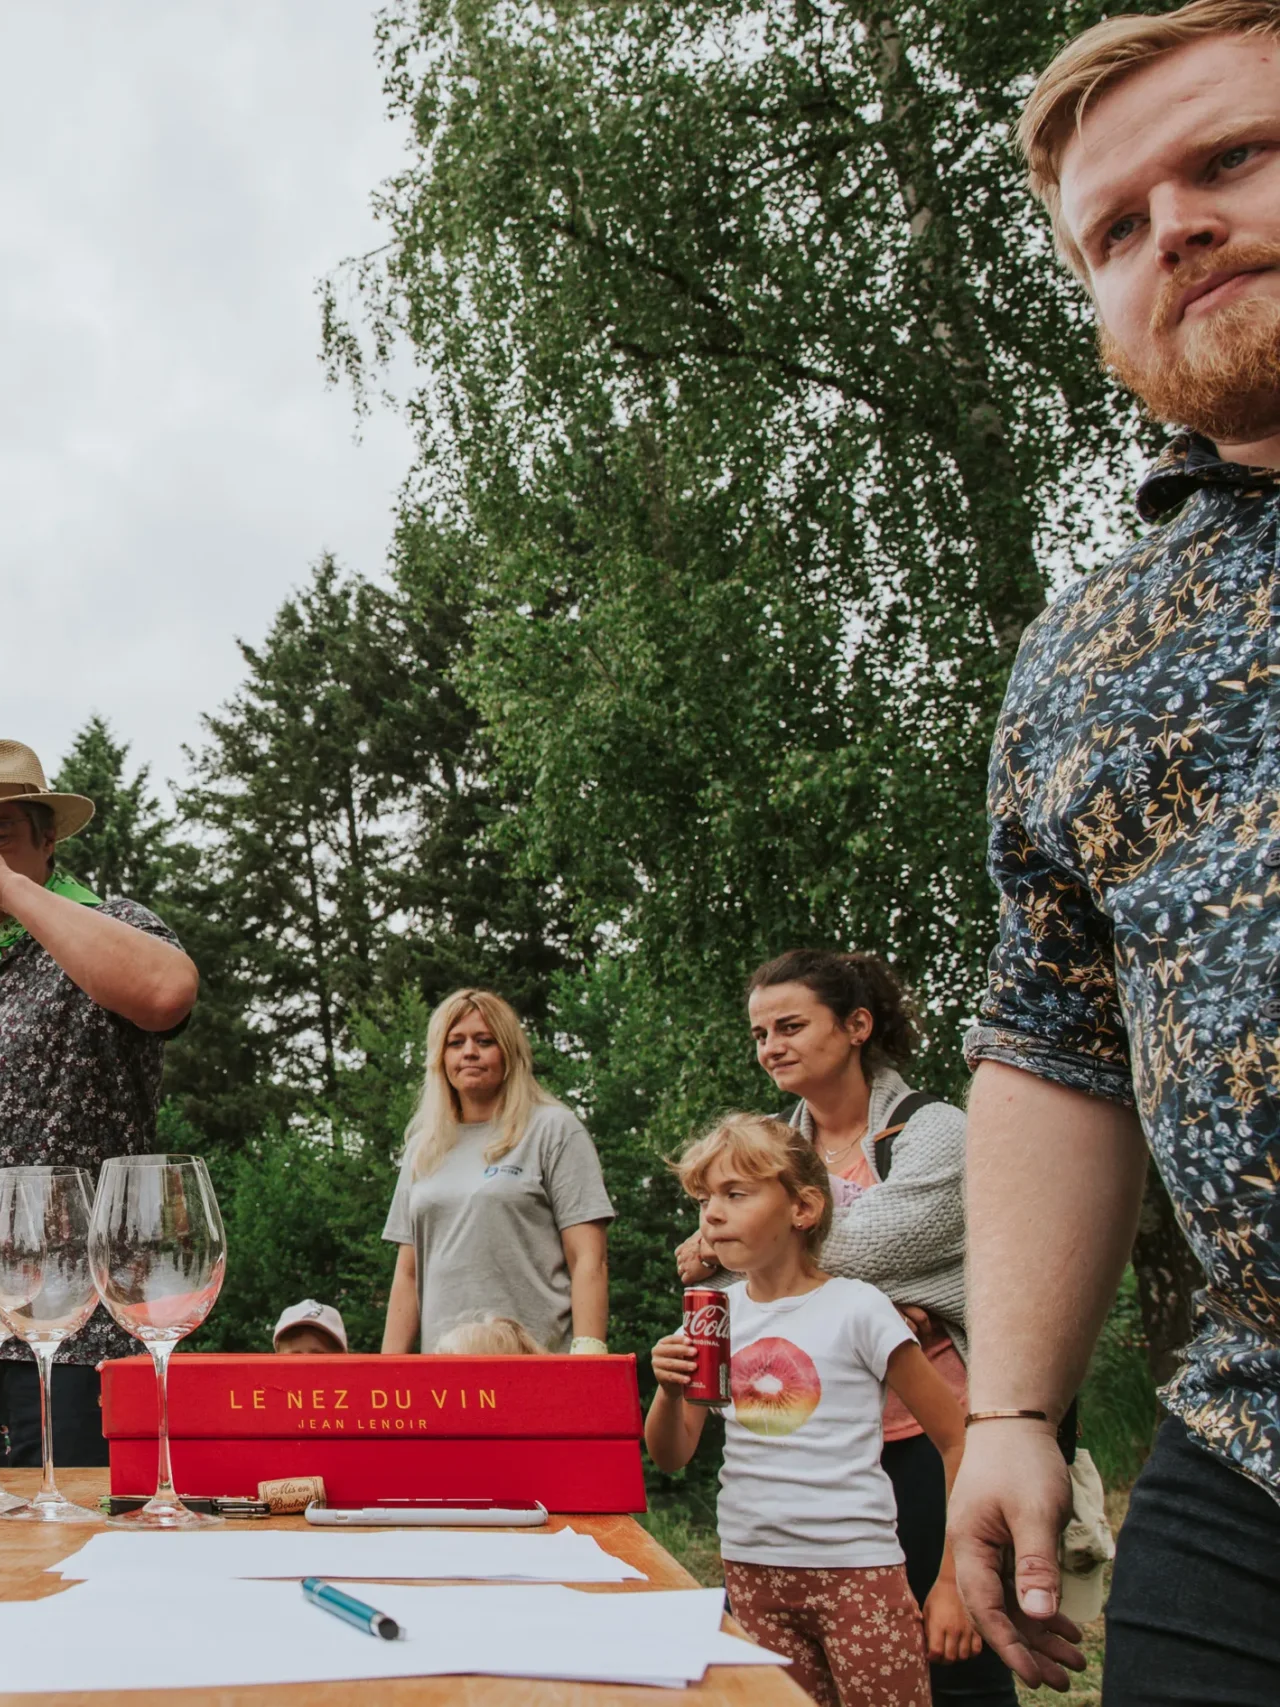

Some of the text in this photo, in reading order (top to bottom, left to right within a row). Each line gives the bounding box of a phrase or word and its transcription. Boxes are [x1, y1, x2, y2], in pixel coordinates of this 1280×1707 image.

[230, 1389, 496, 1409] LE NEZ DU VIN
[298, 1419, 427, 1430] JEAN LENOIR
[270, 1481, 296, 1496] Mis
[269, 1494, 314, 1510] Bouteill
